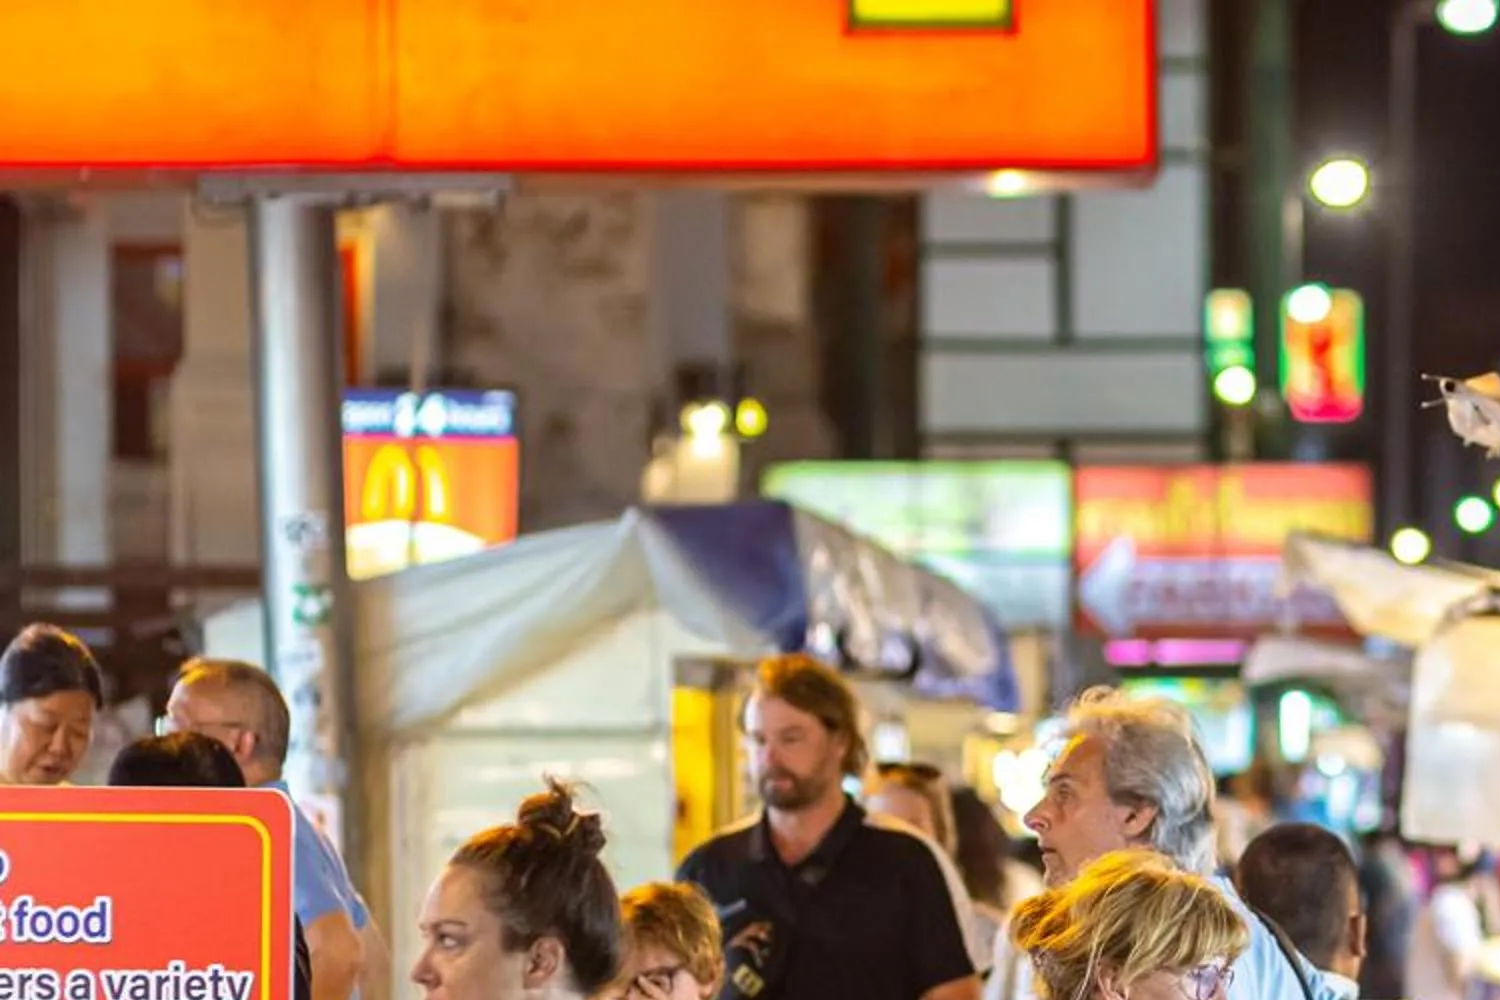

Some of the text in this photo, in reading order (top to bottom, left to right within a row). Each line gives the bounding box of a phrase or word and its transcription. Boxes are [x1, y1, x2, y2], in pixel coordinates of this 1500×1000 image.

[14, 899, 108, 938] food
[0, 972, 56, 1000] ers
[68, 976, 91, 1000] a
